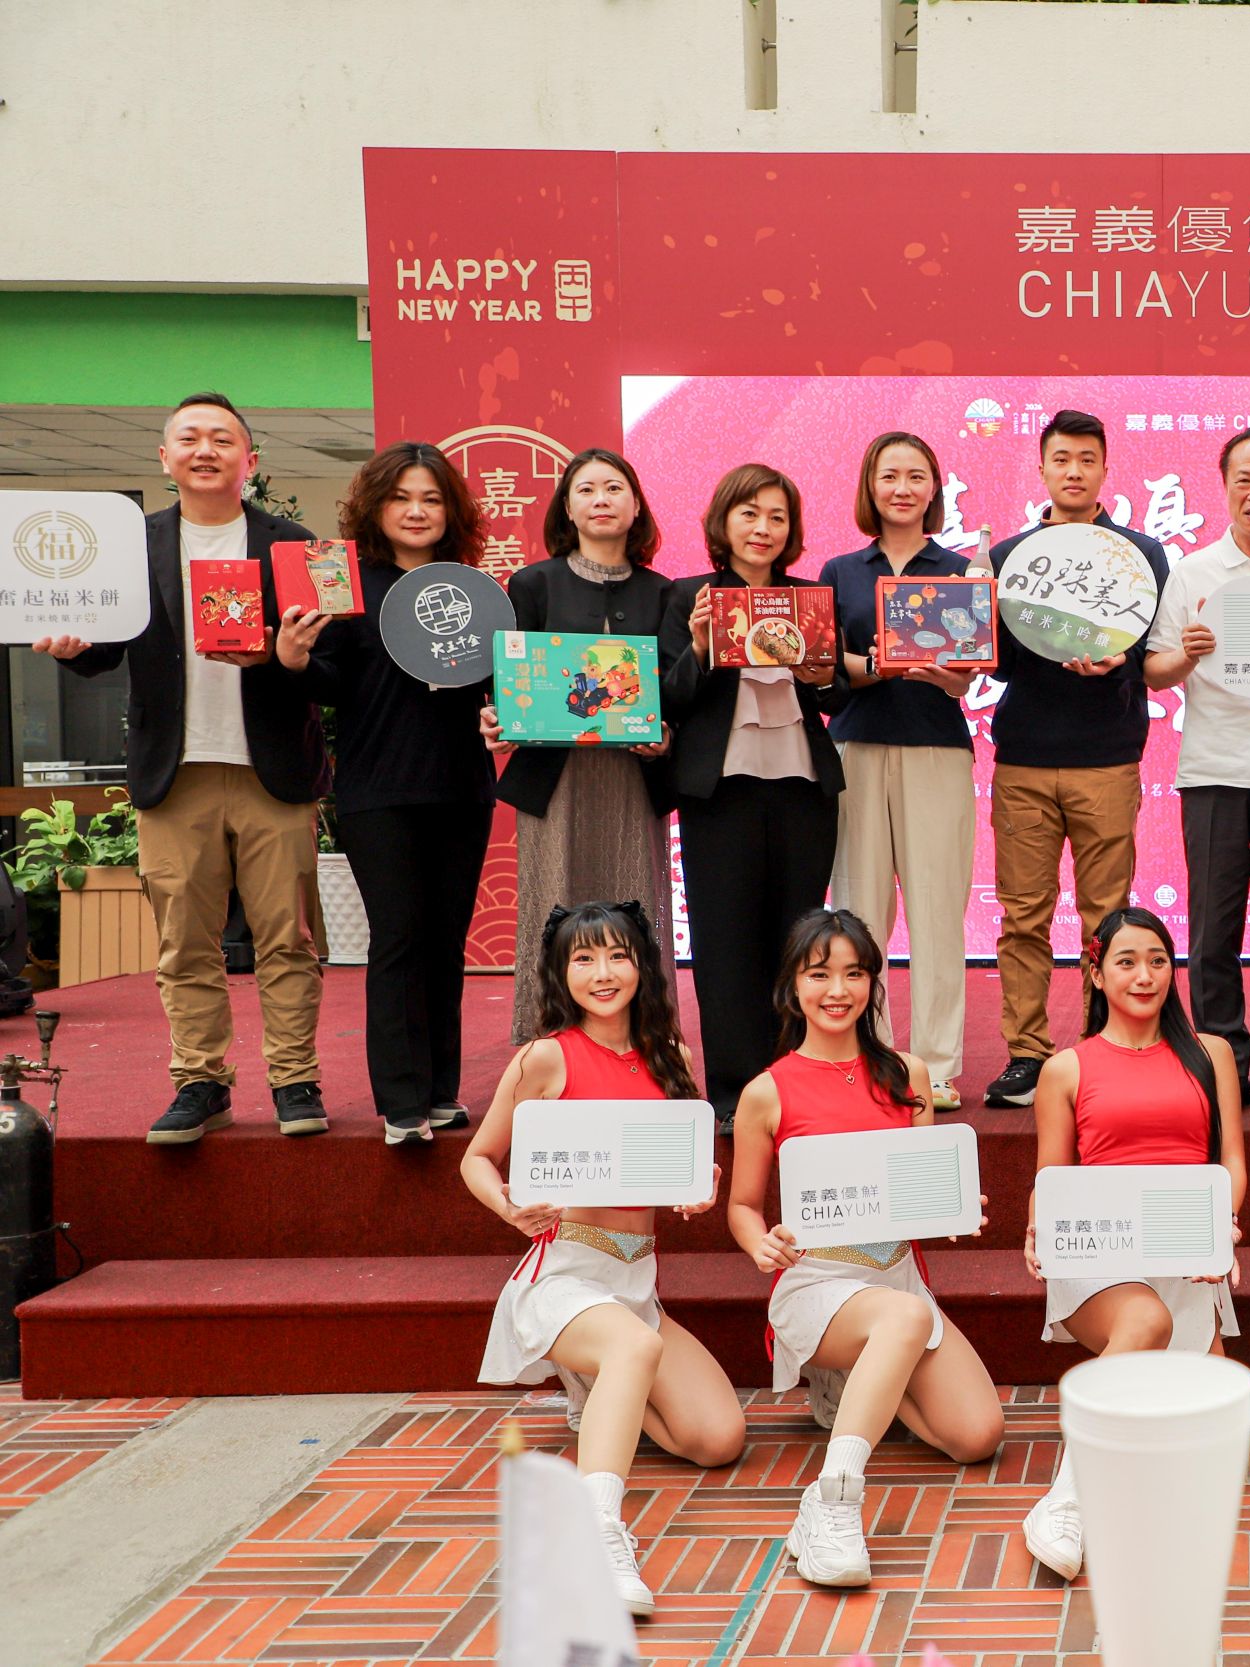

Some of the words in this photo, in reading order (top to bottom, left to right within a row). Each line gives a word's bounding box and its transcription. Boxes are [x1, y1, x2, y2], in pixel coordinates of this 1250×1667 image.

[397, 258, 537, 291] HAPPY
[398, 299, 458, 321] NEW
[469, 299, 542, 321] YEAR
[1024, 403, 1043, 411] 2026
[1125, 414, 1226, 431] 嘉義優鮮
[37, 526, 76, 561] 福
[1018, 608, 1110, 648] 純米大吟釀
[530, 1150, 612, 1164] 嘉義優鮮
[530, 1167, 612, 1181] CHIAYUM
[800, 1184, 880, 1204] 嘉義優鮮
[801, 1201, 881, 1221] CHIAYUM
[1055, 1219, 1133, 1233] 嘉義優鮮
[1055, 1236, 1133, 1250] CHIAYUM
